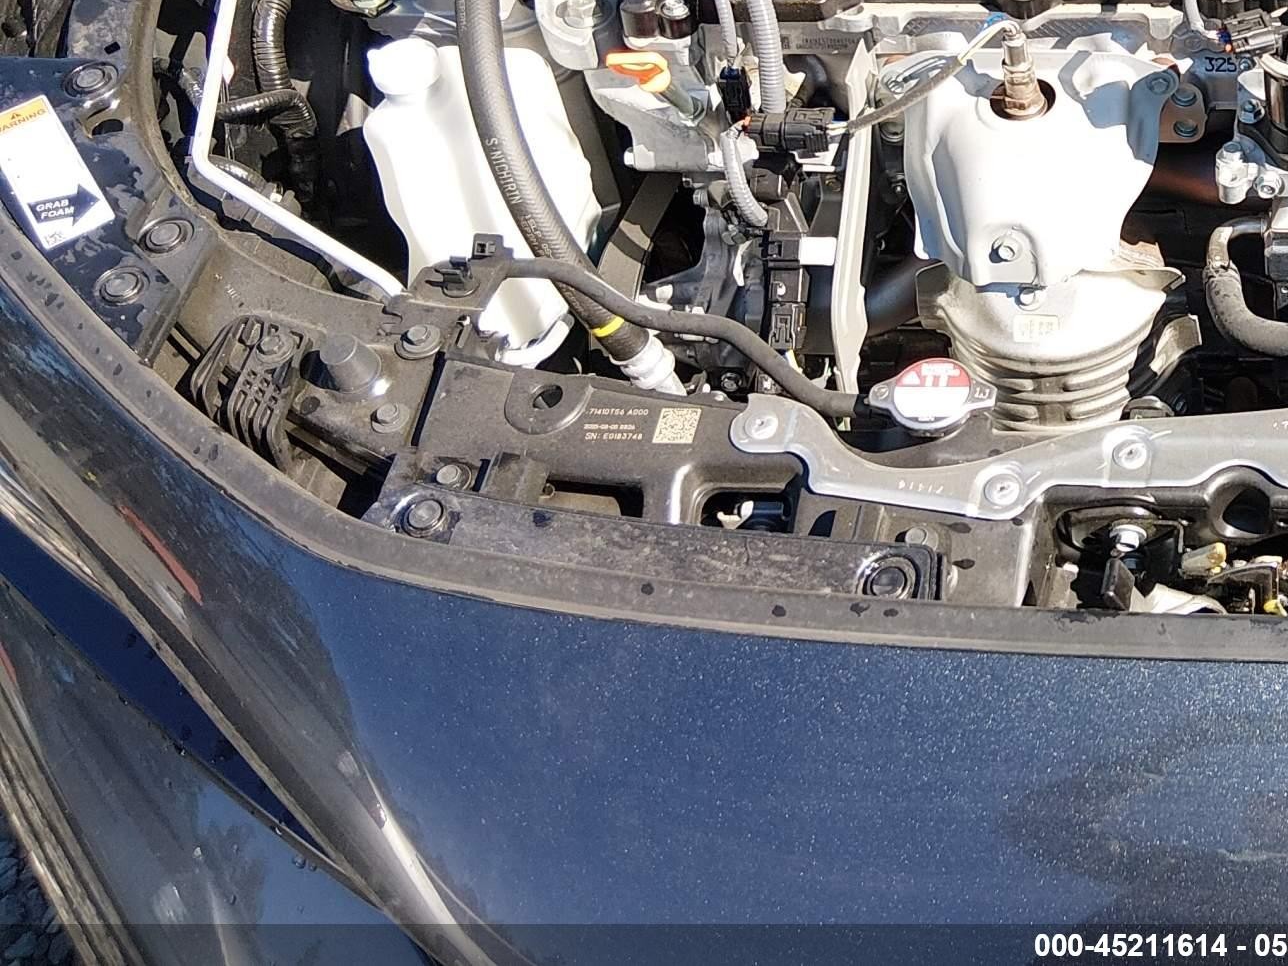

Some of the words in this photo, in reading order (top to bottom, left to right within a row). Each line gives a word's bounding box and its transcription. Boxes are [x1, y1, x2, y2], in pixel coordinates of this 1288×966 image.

[1205, 57, 1237, 72] 325
[0, 109, 46, 132] ARNING
[36, 199, 69, 211] GRAB
[40, 207, 74, 219] FOAM
